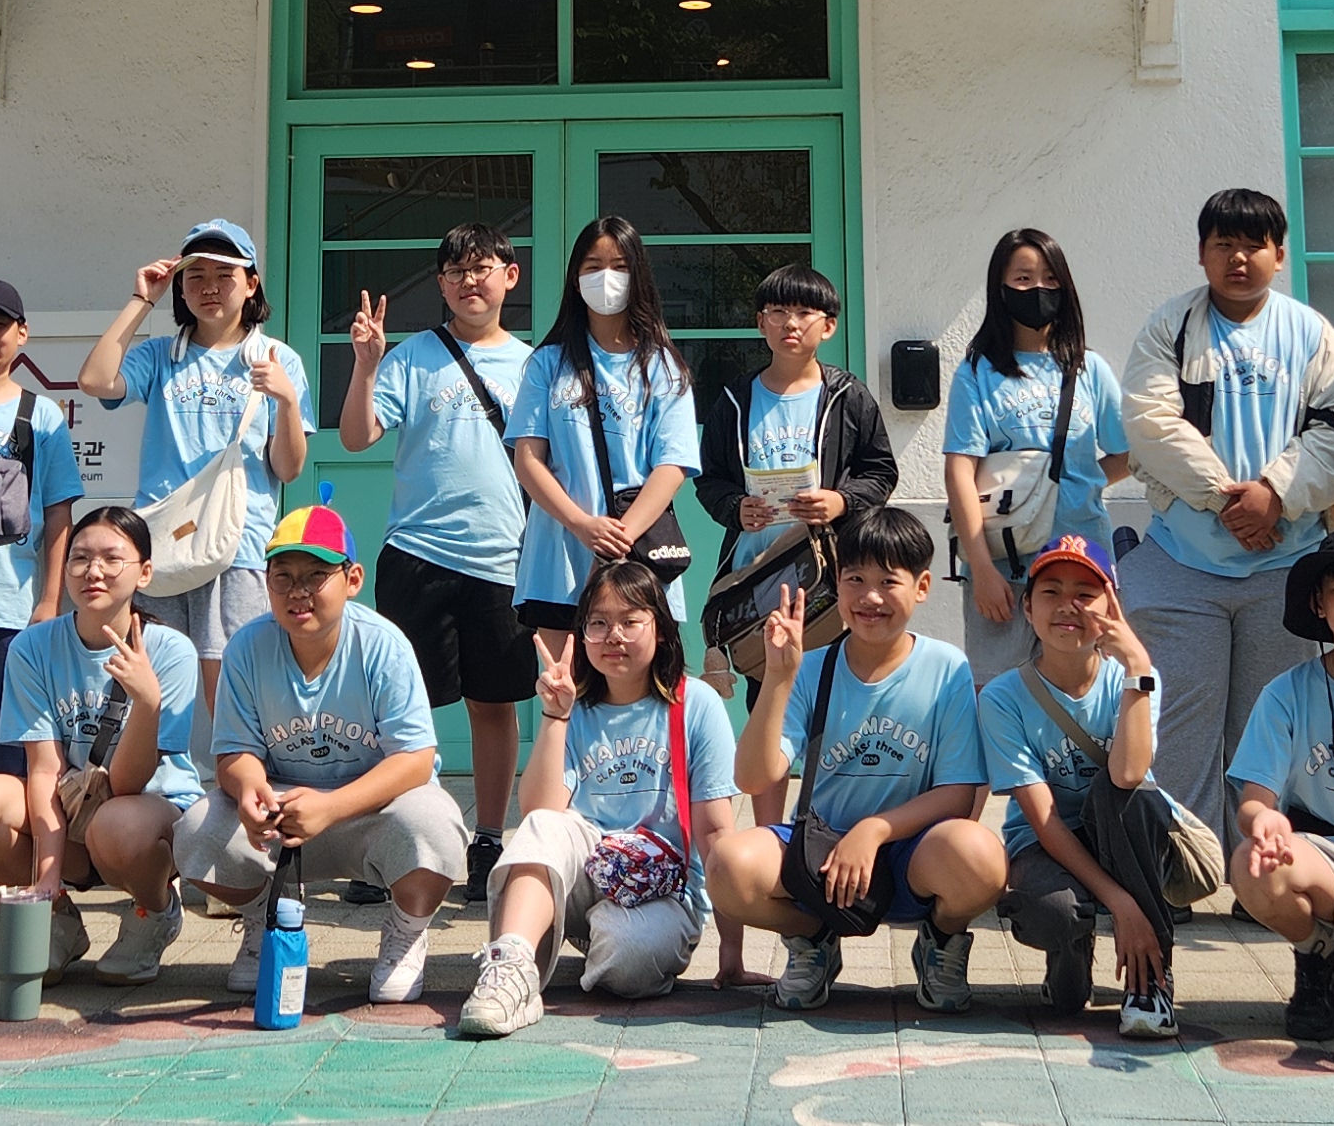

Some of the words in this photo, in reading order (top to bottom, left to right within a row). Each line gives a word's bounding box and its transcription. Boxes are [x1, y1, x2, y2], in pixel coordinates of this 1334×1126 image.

[163, 371, 254, 401] CHAMPIO
[80, 472, 104, 482] eum
[648, 545, 691, 561] adidas
[322, 733, 351, 753] three
[819, 716, 929, 772] CHAMPION
[874, 741, 905, 762] three
[595, 759, 627, 783] CLASS
[632, 759, 656, 778] three
